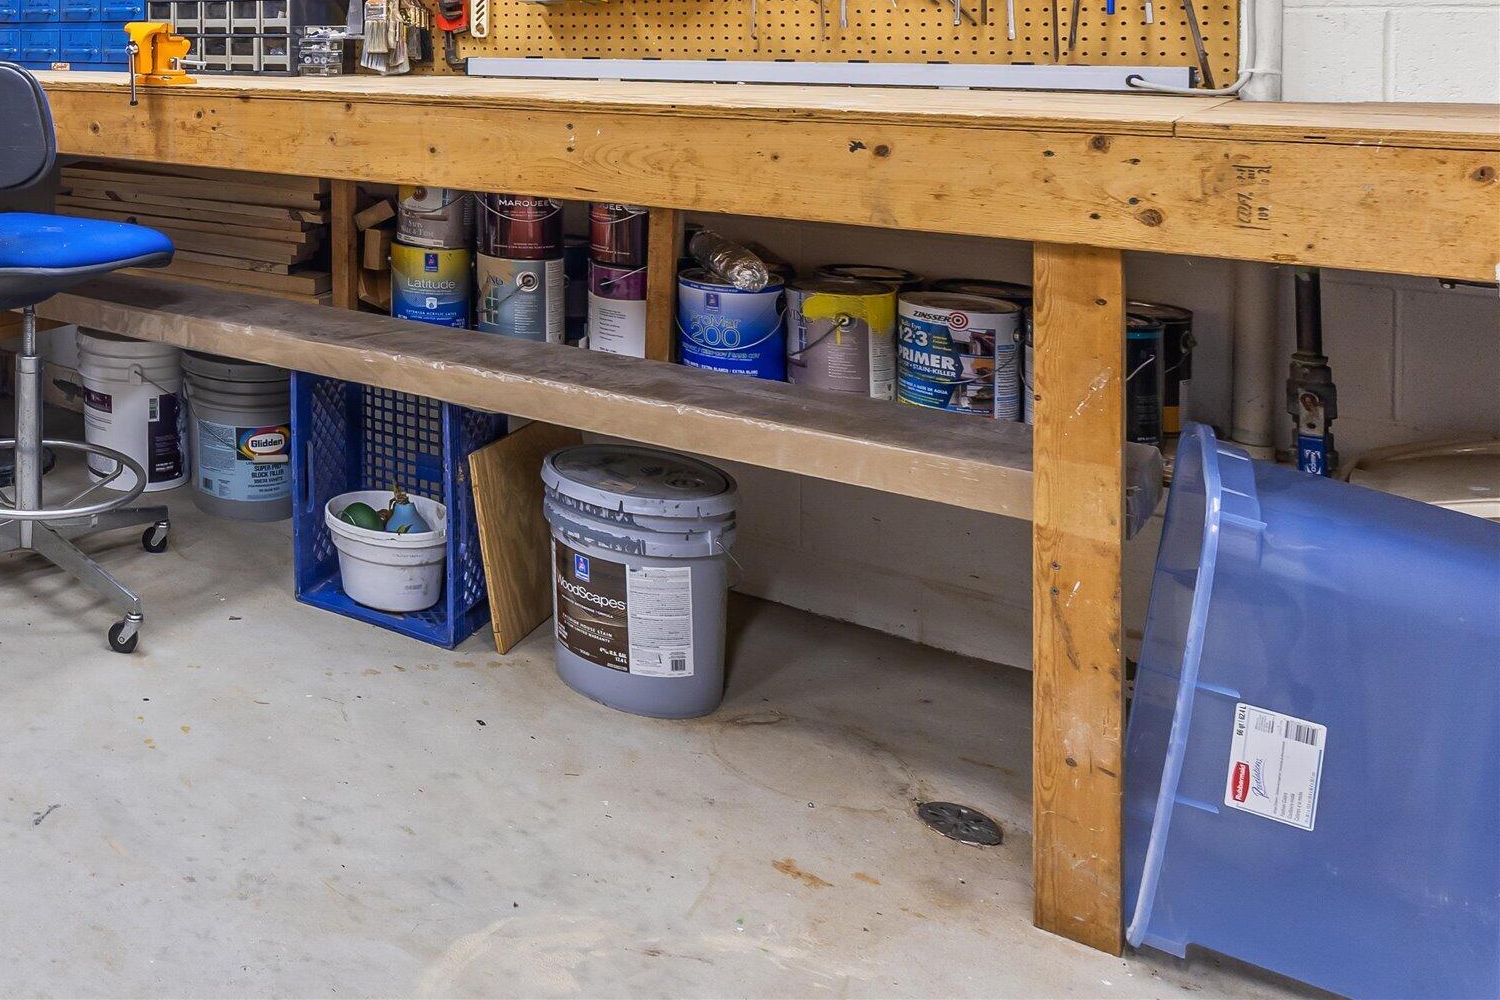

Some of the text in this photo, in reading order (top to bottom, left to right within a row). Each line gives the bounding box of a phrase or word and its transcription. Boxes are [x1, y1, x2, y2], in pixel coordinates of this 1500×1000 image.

[499, 199, 549, 207] MARQUEE
[407, 277, 457, 290] Latitude
[913, 310, 952, 323] ZINSSER
[690, 322, 741, 348] 200
[899, 345, 956, 371] PRIMER
[250, 438, 283, 448] Glidden
[557, 574, 626, 611] WoodScapes
[1235, 764, 1246, 800] Rubbermaid
